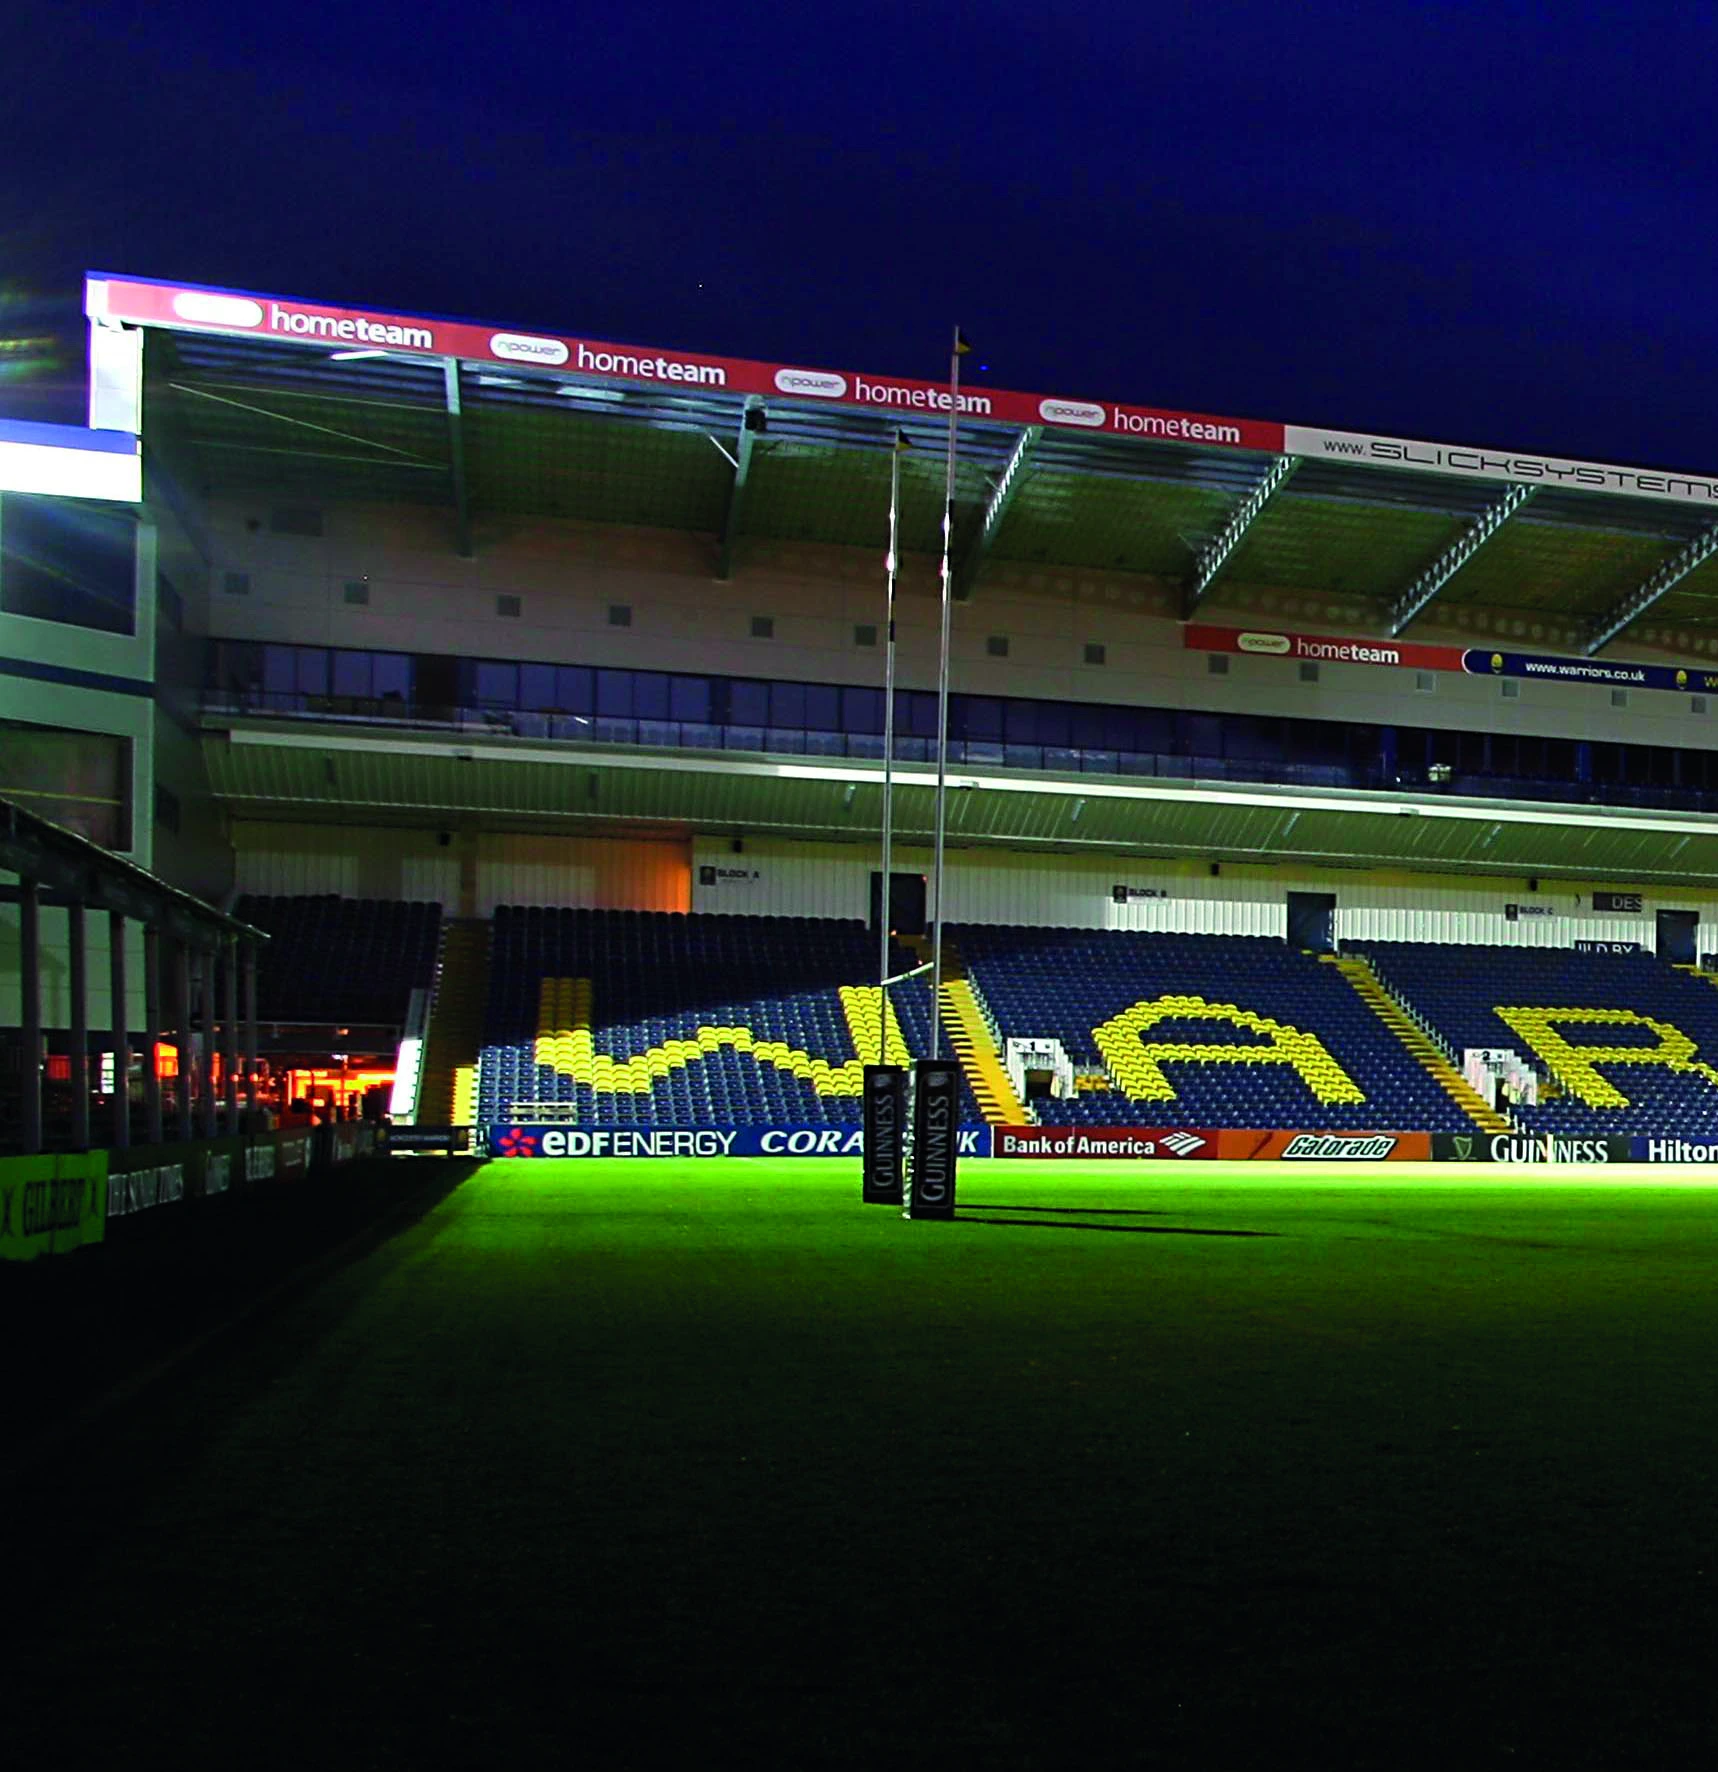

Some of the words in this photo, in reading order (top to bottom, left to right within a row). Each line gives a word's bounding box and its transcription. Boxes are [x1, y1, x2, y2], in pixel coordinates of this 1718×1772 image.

[270, 304, 432, 348] hometeam
[578, 344, 726, 385] hometeam
[856, 378, 991, 414] hometeam
[1114, 408, 1240, 443] hometeam
[1298, 638, 1399, 663] hometeam
[1525, 661, 1645, 682] www.warriors.co.uk
[872, 1094, 895, 1187] GUINNESS
[921, 1095, 949, 1201] GUINNESS
[1003, 1135, 1053, 1154] Bank
[1055, 1136, 1074, 1155] of
[1077, 1138, 1154, 1156] America
[1286, 1135, 1392, 1157] Gatorade
[1490, 1134, 1608, 1163] GUINNESS
